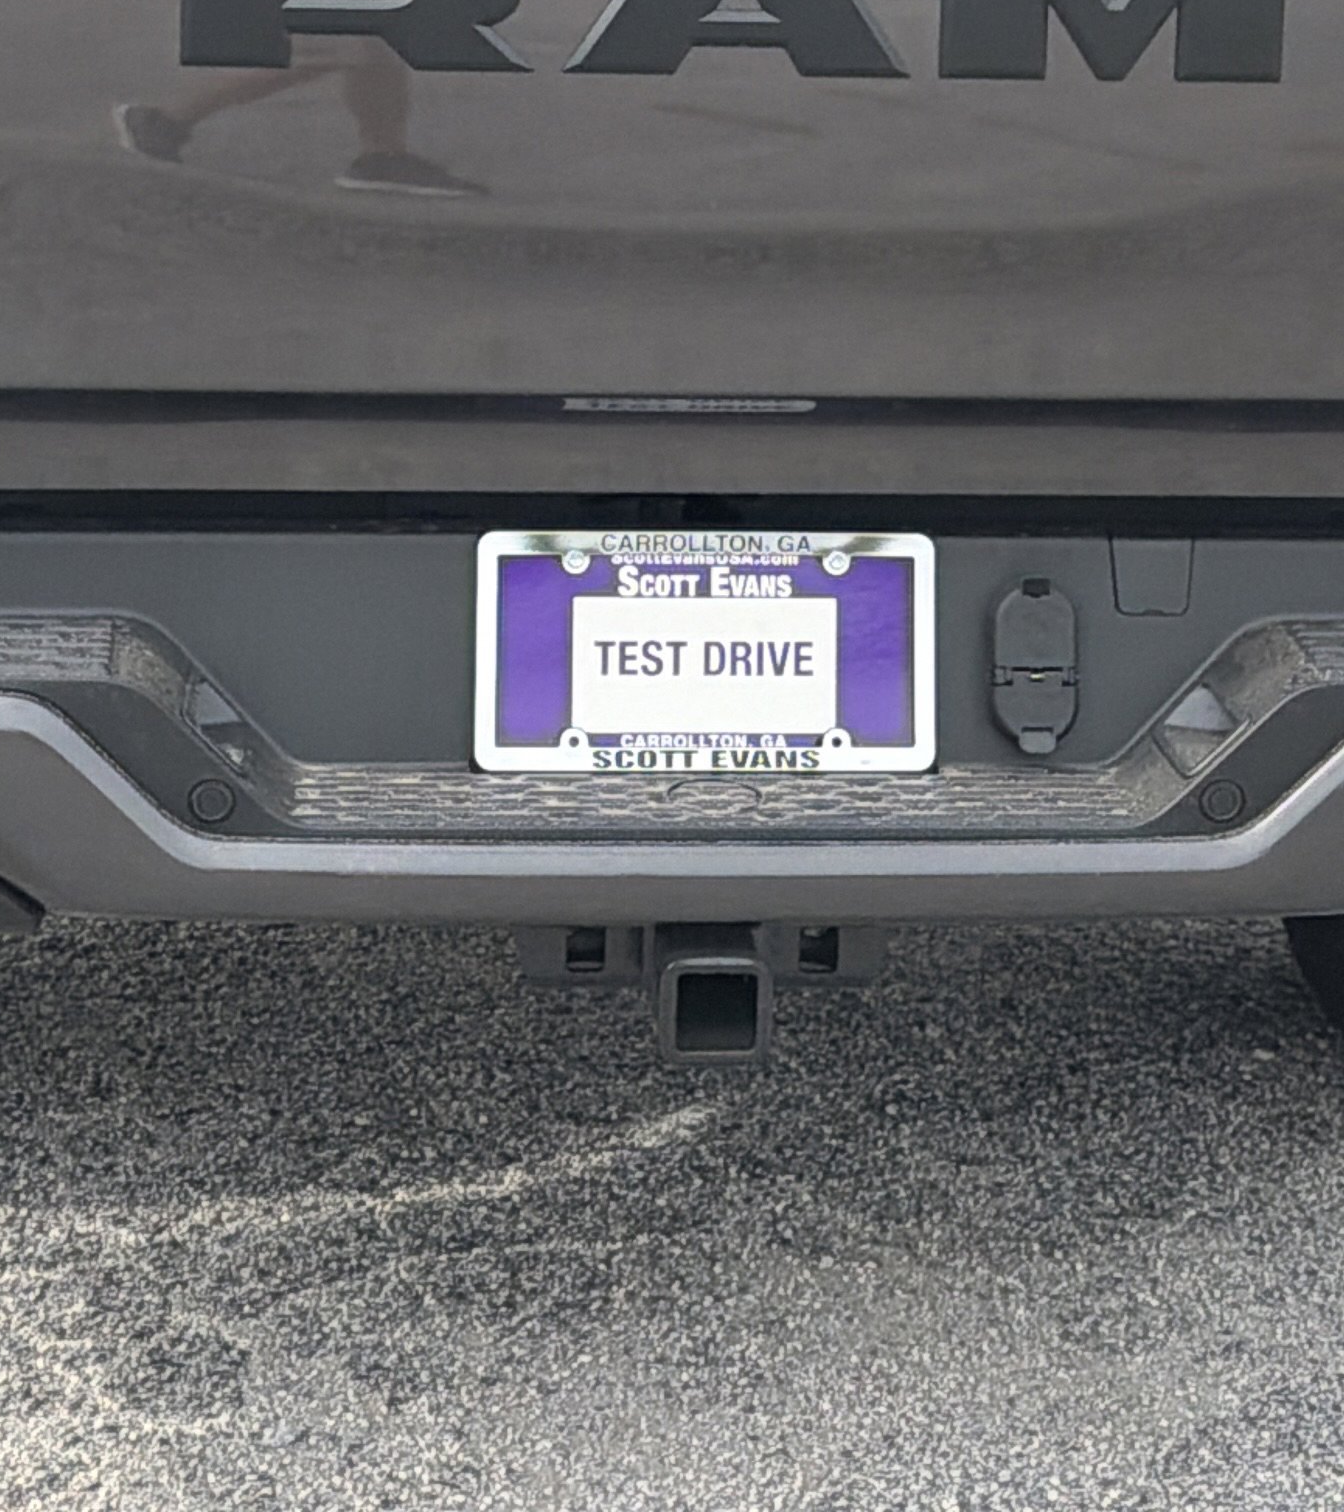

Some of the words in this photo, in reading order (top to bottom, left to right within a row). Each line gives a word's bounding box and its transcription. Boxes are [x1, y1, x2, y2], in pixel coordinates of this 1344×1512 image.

[777, 534, 812, 553] GA
[594, 640, 688, 677] TEST
[702, 640, 815, 677] DRIVE
[759, 734, 788, 748] GA
[592, 749, 699, 769] SCOTT
[711, 749, 821, 769] EVANS
